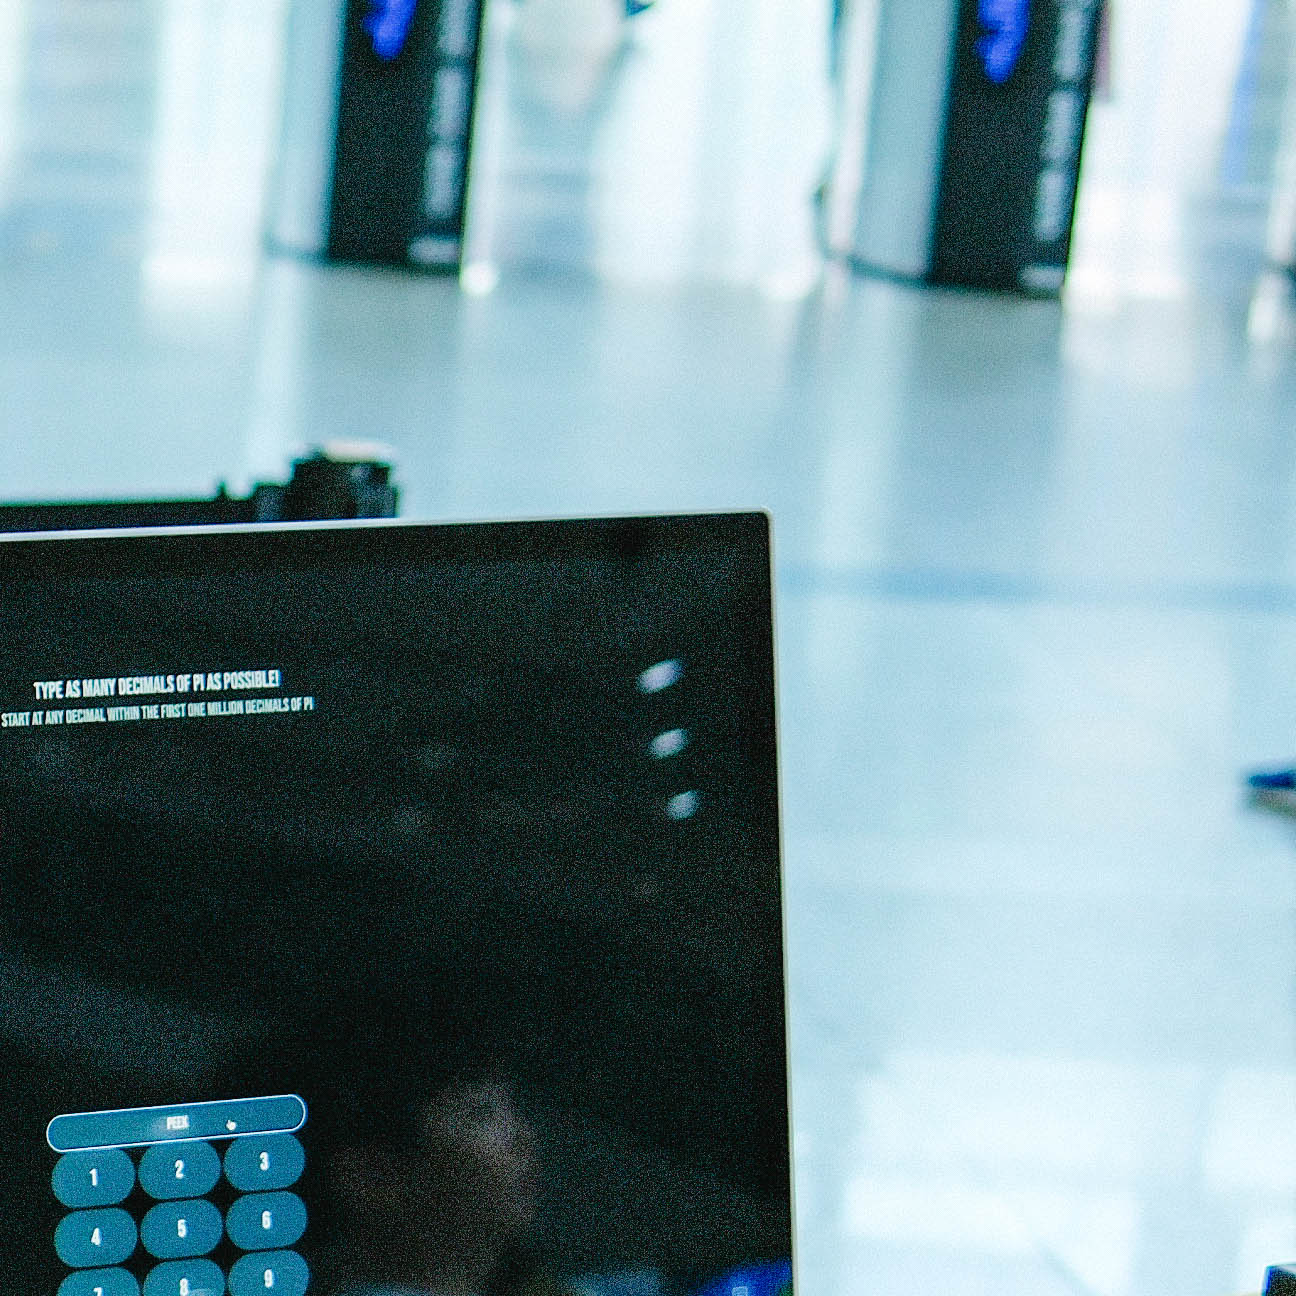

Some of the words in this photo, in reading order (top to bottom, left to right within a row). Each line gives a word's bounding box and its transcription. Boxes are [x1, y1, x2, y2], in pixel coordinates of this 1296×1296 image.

[33, 680, 64, 700] TYPE
[65, 679, 81, 698] AS
[82, 677, 116, 697] MANY
[117, 674, 175, 696] DECIMALS
[176, 673, 192, 693] OF
[193, 672, 206, 692] PI
[206, 671, 222, 691] AS
[223, 669, 281, 690] POSSIBLE!
[1, 711, 31, 728] START
[32, 710, 45, 726] AT
[45, 710, 64, 725] ANY
[65, 707, 106, 724] DECIMAL
[106, 705, 140, 722] WITHIN
[141, 704, 160, 720] THE
[160, 703, 187, 719] FIRST
[187, 701, 206, 717] ONE
[206, 699, 244, 716] MILLION
[245, 697, 289, 714] DECIMALS
[290, 696, 303, 712] OF
[303, 696, 315, 711] PI
[89, 1168, 99, 1187] 1
[174, 1159, 185, 1180] 2
[259, 1151, 271, 1171] 3
[90, 1227, 103, 1246] 4
[176, 1218, 187, 1239] 5
[261, 1210, 272, 1230] 6
[179, 1277, 190, 1296] 8
[264, 1268, 275, 1289] 9
